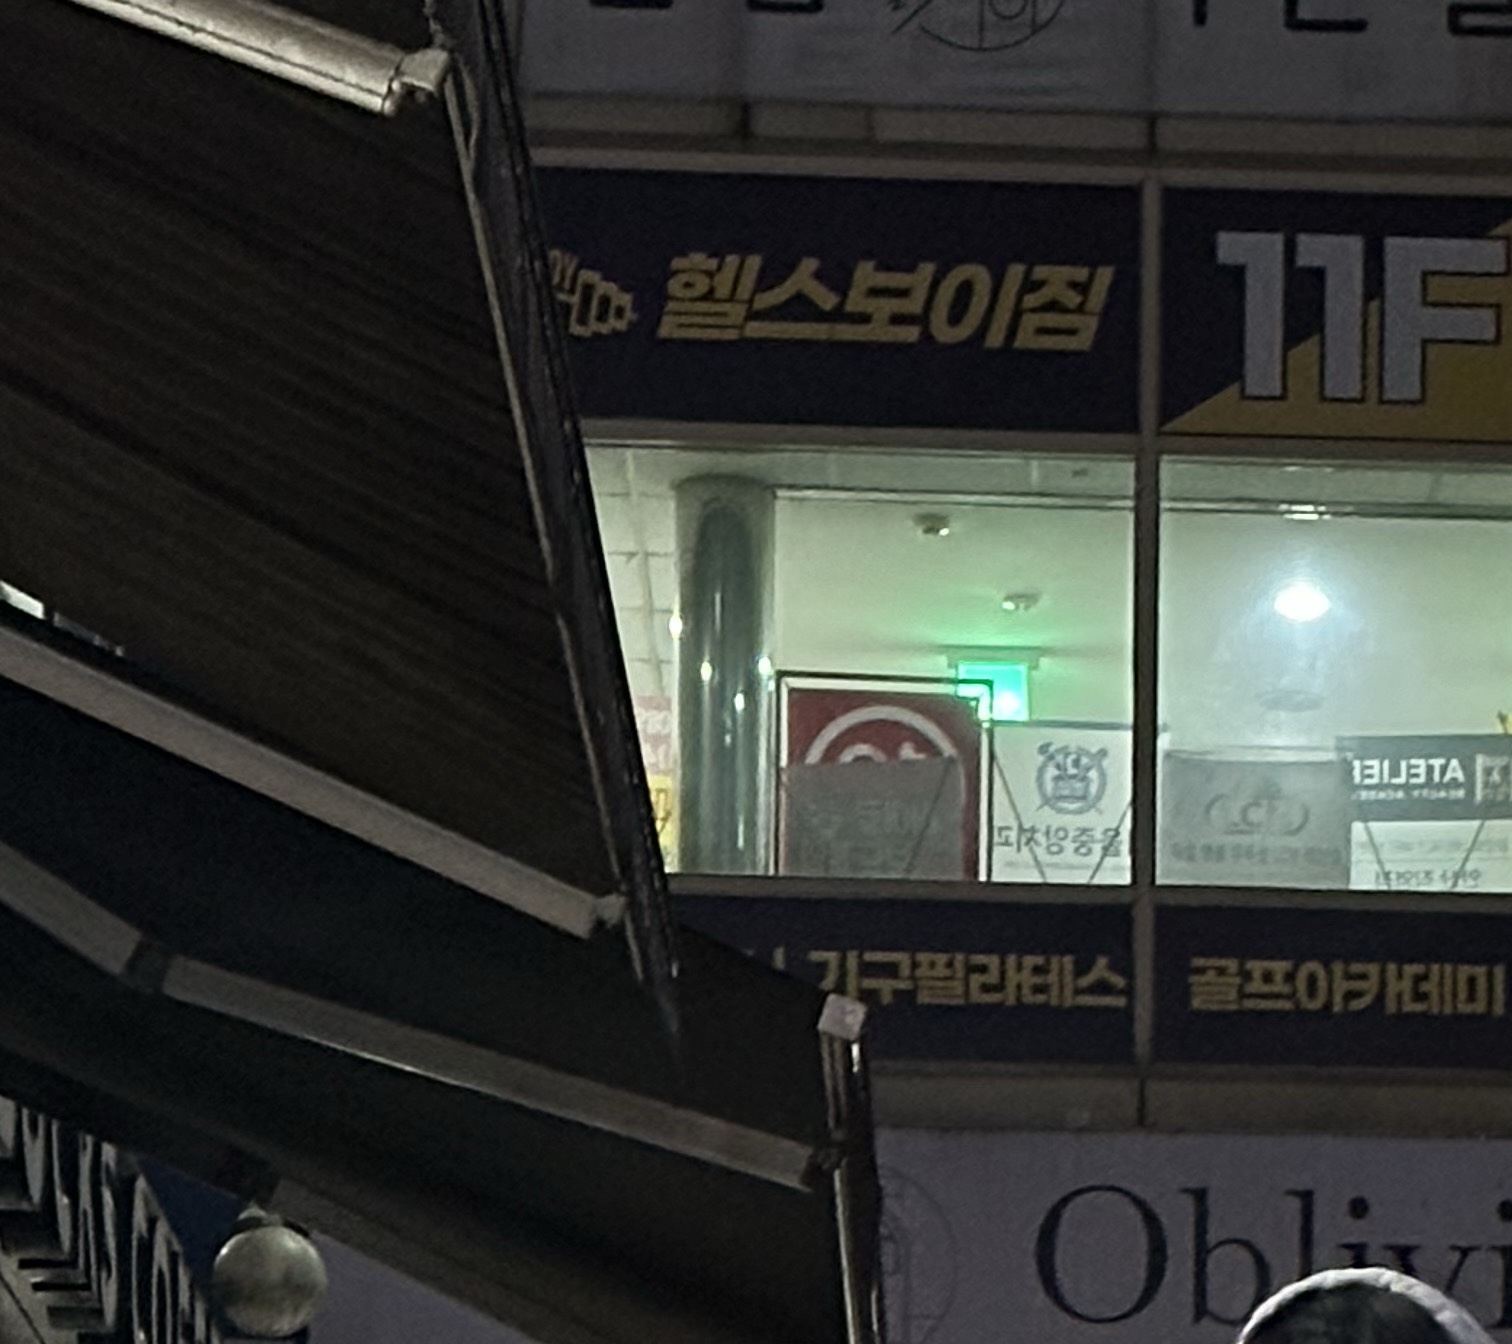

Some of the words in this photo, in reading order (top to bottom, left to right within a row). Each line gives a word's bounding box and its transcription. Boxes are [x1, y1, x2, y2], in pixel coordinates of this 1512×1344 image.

[657, 250, 1115, 352] 헬스보이짐
[1215, 230, 1510, 404] 11F
[807, 949, 1128, 1009] 기구필라테스
[1188, 956, 1506, 1017] 골프아카데미
